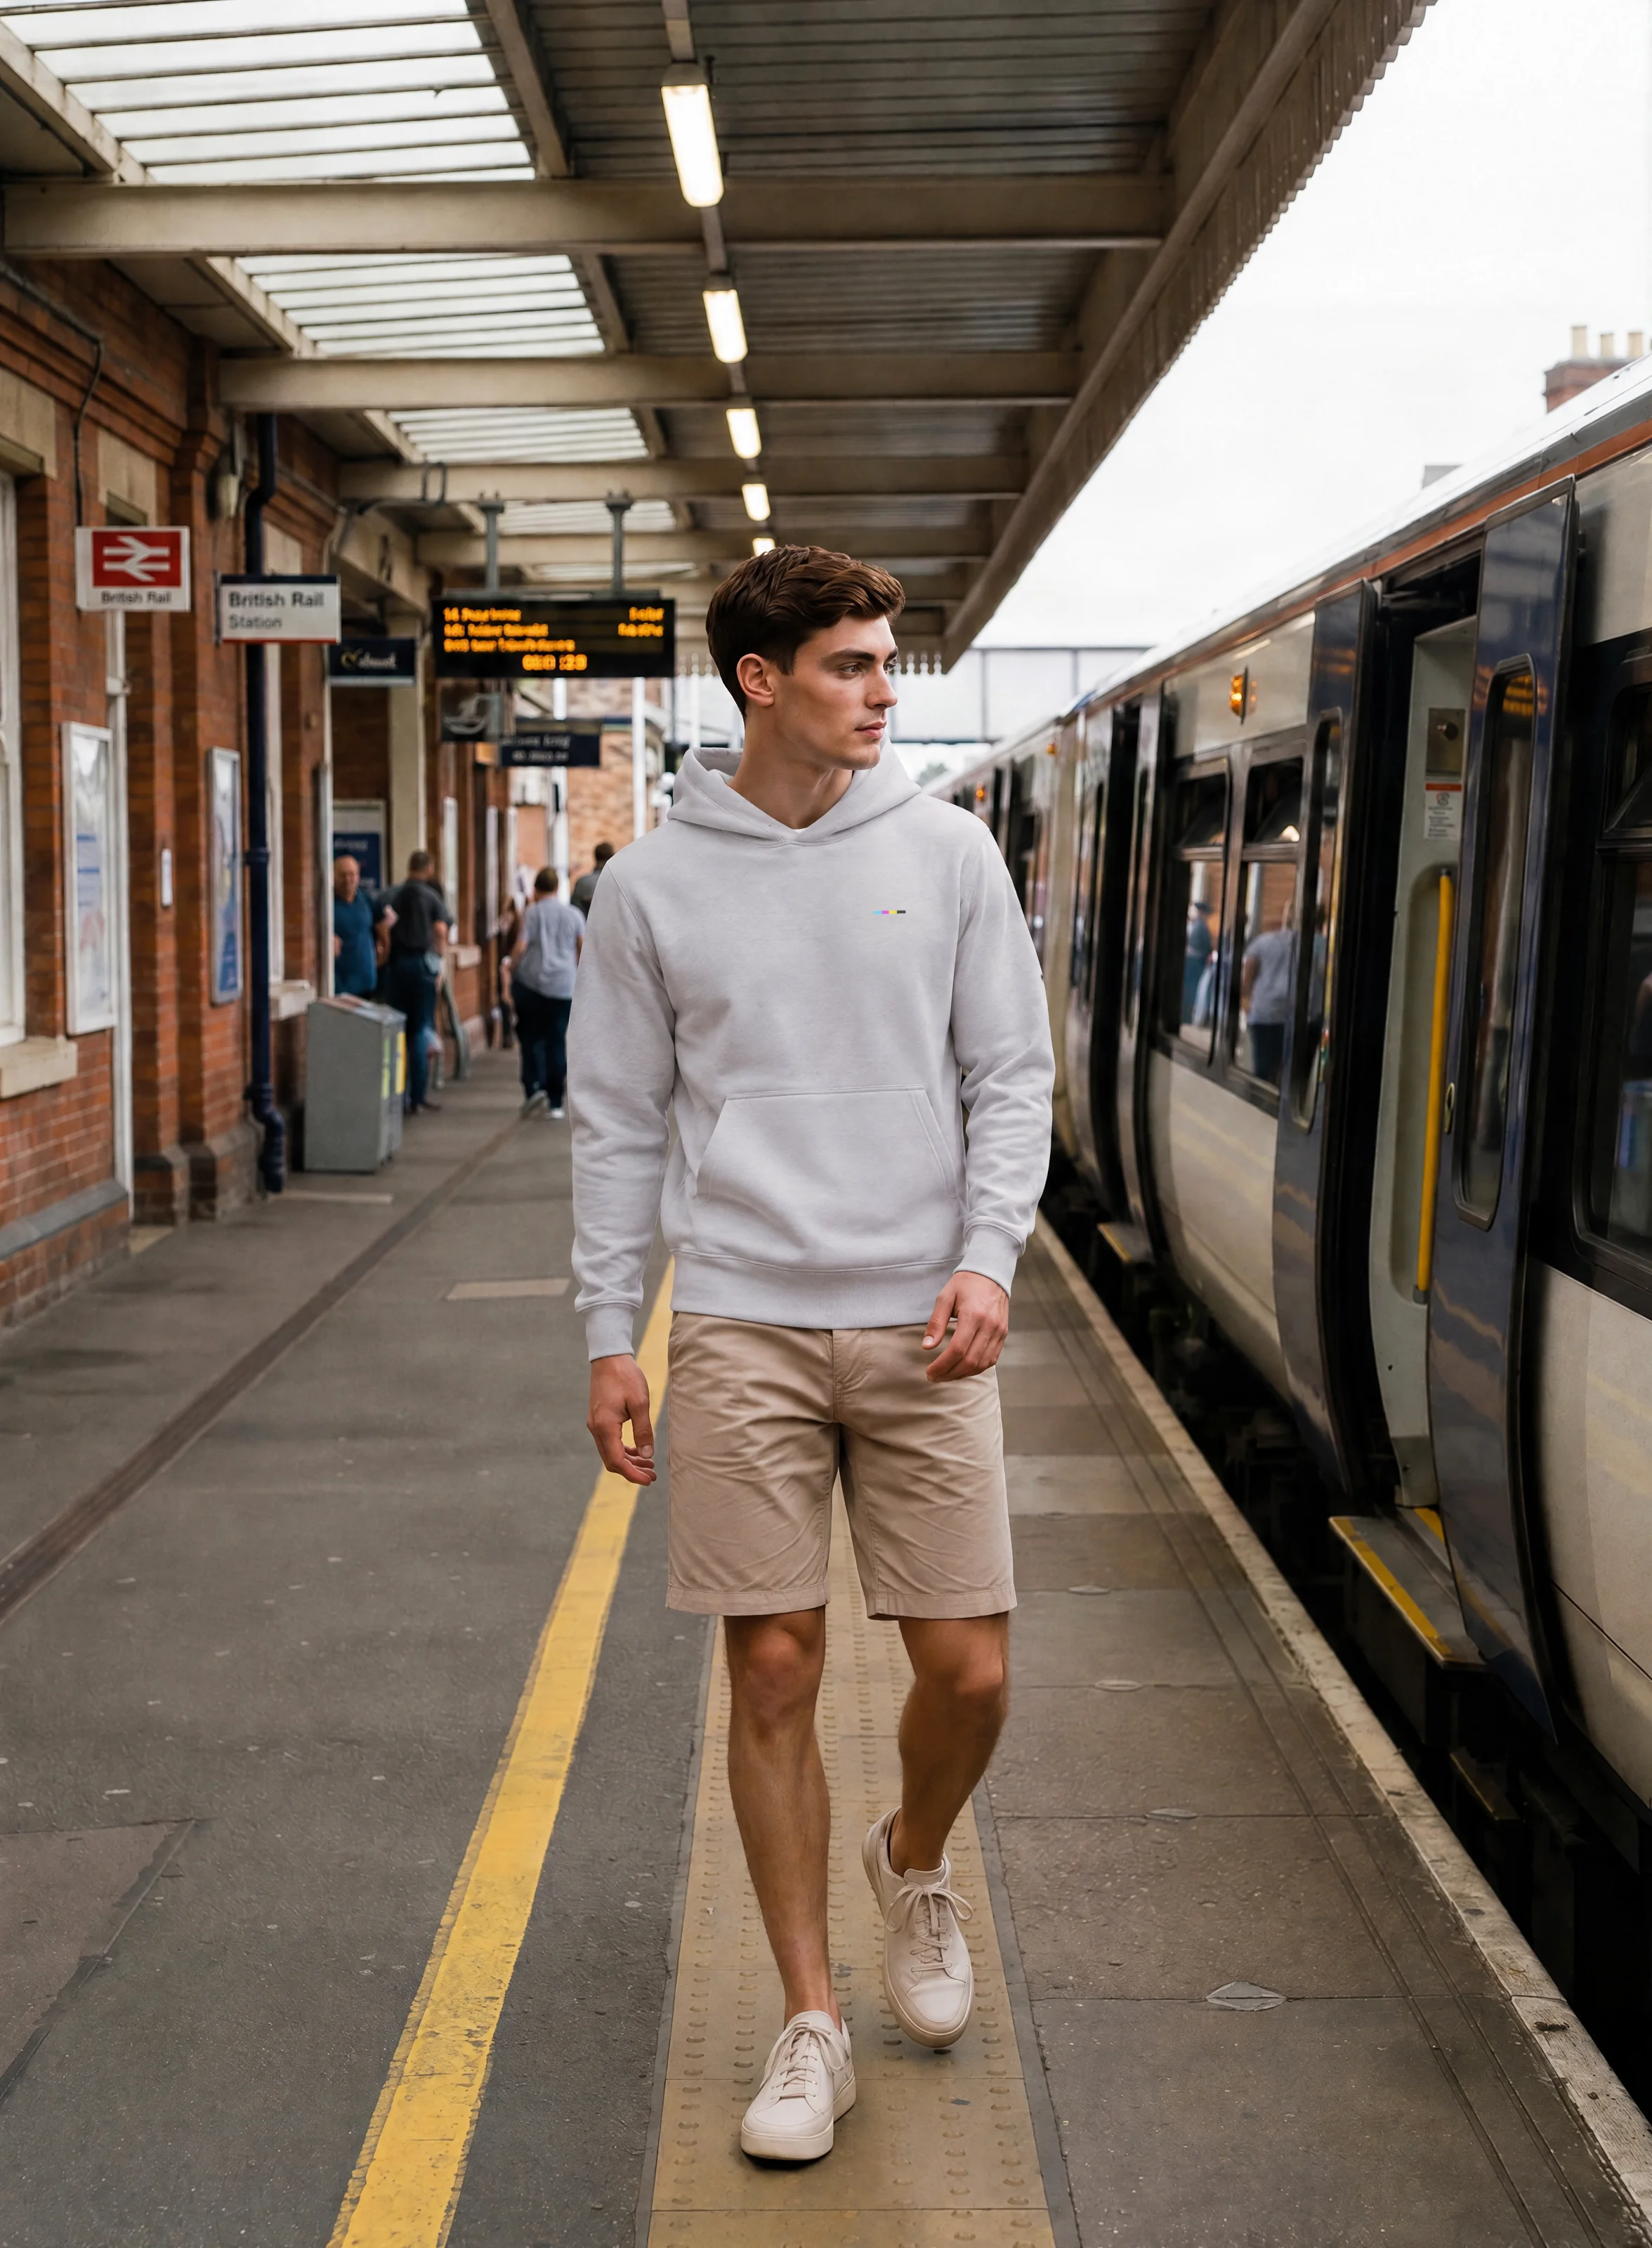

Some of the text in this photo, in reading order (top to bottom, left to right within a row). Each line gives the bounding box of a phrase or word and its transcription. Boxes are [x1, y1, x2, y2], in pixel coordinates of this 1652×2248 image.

[146, 590, 172, 605] Rail
[229, 591, 324, 608] British Rail
[228, 613, 283, 630] Station
